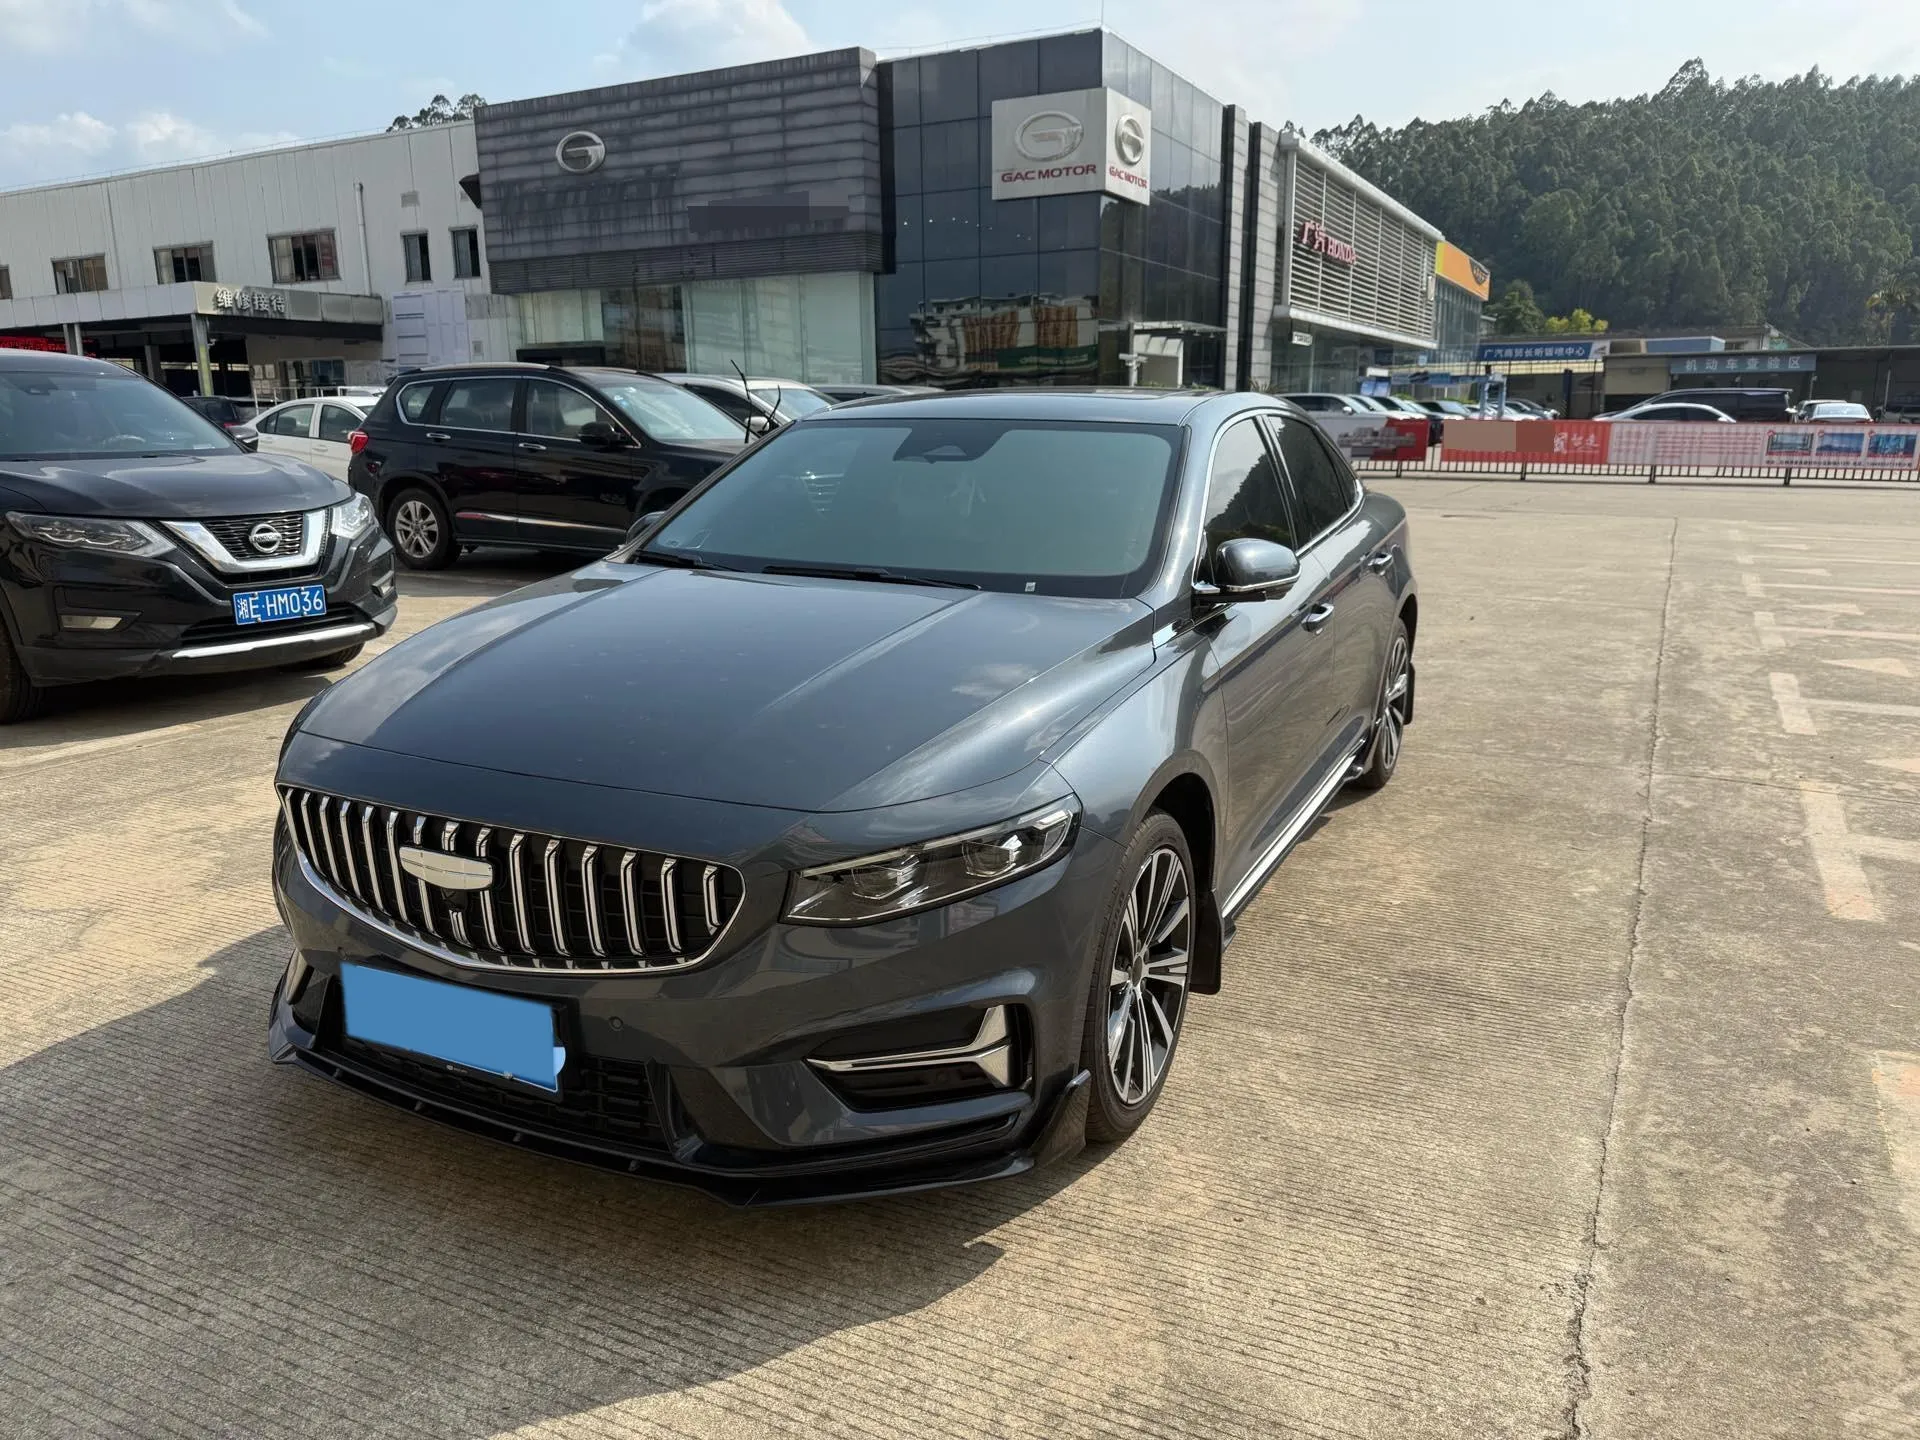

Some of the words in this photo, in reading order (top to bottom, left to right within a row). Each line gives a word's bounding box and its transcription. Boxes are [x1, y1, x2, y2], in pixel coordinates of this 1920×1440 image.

[1001, 170, 1035, 183] GAC
[1037, 164, 1097, 180] MOTOR
[1109, 166, 1125, 181] GAC
[1125, 173, 1148, 189] MOTOR
[216, 287, 286, 313] 维修接待
[1685, 355, 1801, 371] 机动车查验区
